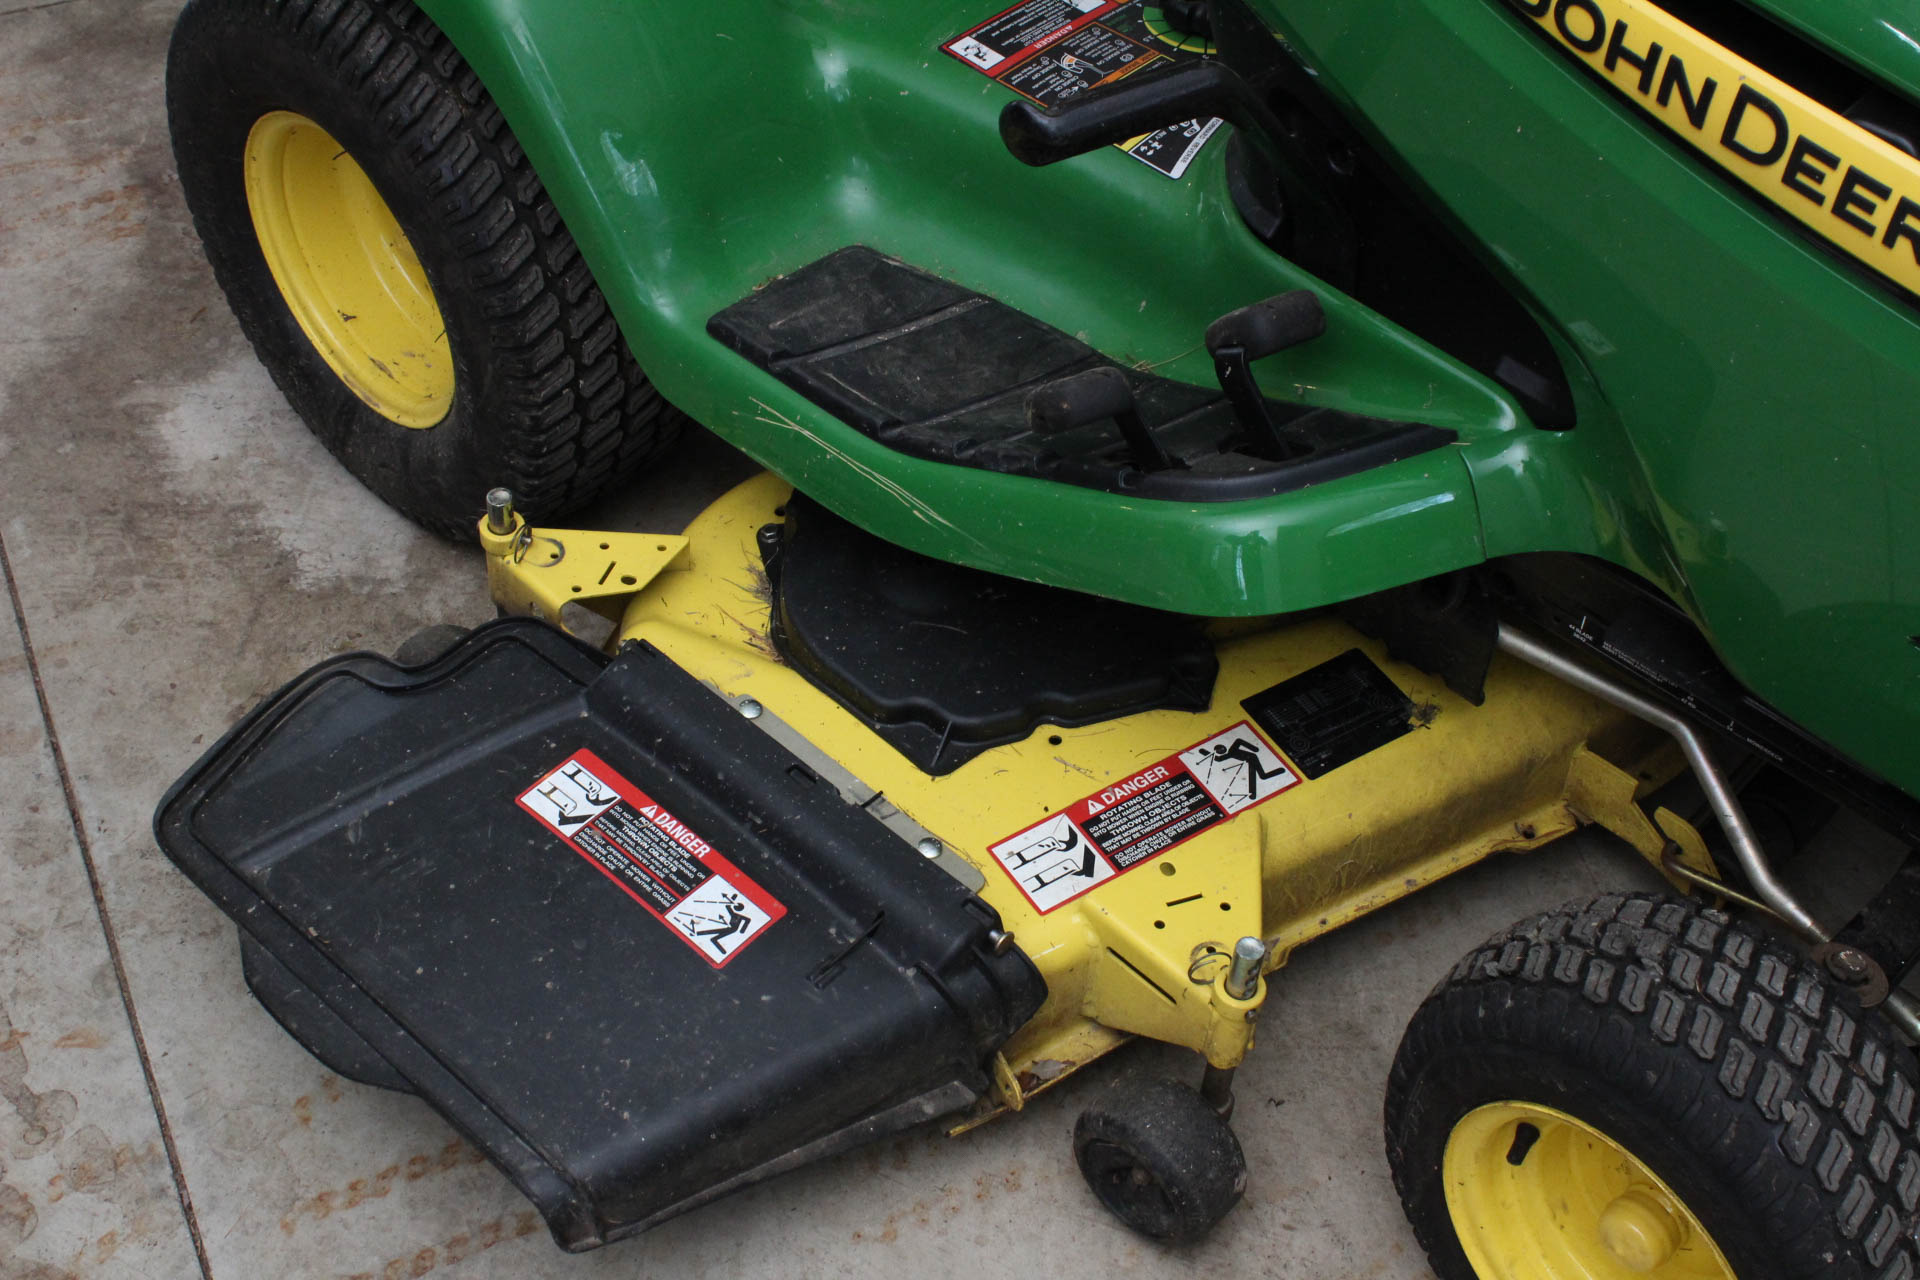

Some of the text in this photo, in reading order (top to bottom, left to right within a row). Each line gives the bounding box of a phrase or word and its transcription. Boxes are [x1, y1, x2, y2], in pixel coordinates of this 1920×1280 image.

[1033, 29, 1069, 49] DANGER
[1089, 825, 1100, 833] DO
[1097, 819, 1111, 828] NOT
[1109, 814, 1123, 822] PUT
[1121, 804, 1142, 817] HANDS
[1149, 793, 1165, 803] FEET
[1163, 783, 1183, 796] UNDER
[1099, 781, 1173, 820] ROTATING BLADE
[1100, 765, 1171, 805] DANGER
[1092, 828, 1108, 838] INTO
[1106, 817, 1129, 831] MOWER
[1127, 808, 1146, 820] WHEN
[1144, 798, 1166, 812] ENGINE
[1170, 783, 1196, 799] RUNNING
[1101, 835, 1123, 848] BEFORE
[1143, 815, 1162, 827] CLEAR
[1160, 808, 1176, 818] AREA
[1181, 793, 1205, 808] OBJECTS
[1106, 842, 1122, 852] THAT
[1120, 836, 1134, 845] MAY
[1140, 820, 1165, 835] THROWN
[1171, 807, 1191, 819] BLADE
[1109, 794, 1188, 837] THROWN OBJECTS
[1123, 845, 1138, 854] NOT
[1136, 831, 1165, 848] OPERATE
[1163, 820, 1187, 834] MOWER
[1185, 807, 1213, 823] WITHOUT
[573, 835, 596, 854] CATCHER
[599, 856, 616, 871] PLACE
[594, 820, 666, 879] THAT MAY BE THROWN BY BLADE
[598, 816, 618, 832] BEFORE
[635, 846, 652, 860] CLEAR
[649, 858, 664, 870] AREA
[661, 867, 671, 875] OF
[668, 873, 692, 892] OBJECTS
[608, 809, 622, 819] INTO
[619, 817, 639, 833] MOWER
[636, 831, 653, 844] WHEN
[650, 842, 669, 857] ENGINE
[672, 860, 696, 879] RUNNING
[613, 805, 707, 880] DO NOT PUT HANDS OR FEET UNDER OR
[621, 826, 679, 872] THROWN OBJECTS
[638, 816, 692, 859] ROTATING BLADE
[653, 813, 712, 859] DANGER
[1117, 844, 1151, 863] DISCHARGE
[1149, 835, 1169, 847] CHUTE
[1176, 821, 1197, 833] ENTIRE
[1196, 811, 1217, 823] GRASS
[1120, 851, 1149, 867] CATCHER
[1153, 838, 1173, 850] PLACE
[578, 831, 672, 908] DISCHARGE CHUTE OR ENTIRE GRASS
[583, 827, 594, 836] DO
[605, 845, 631, 866] OPERATE
[629, 864, 652, 883] MOWER
[650, 882, 677, 904] WITHOUT
